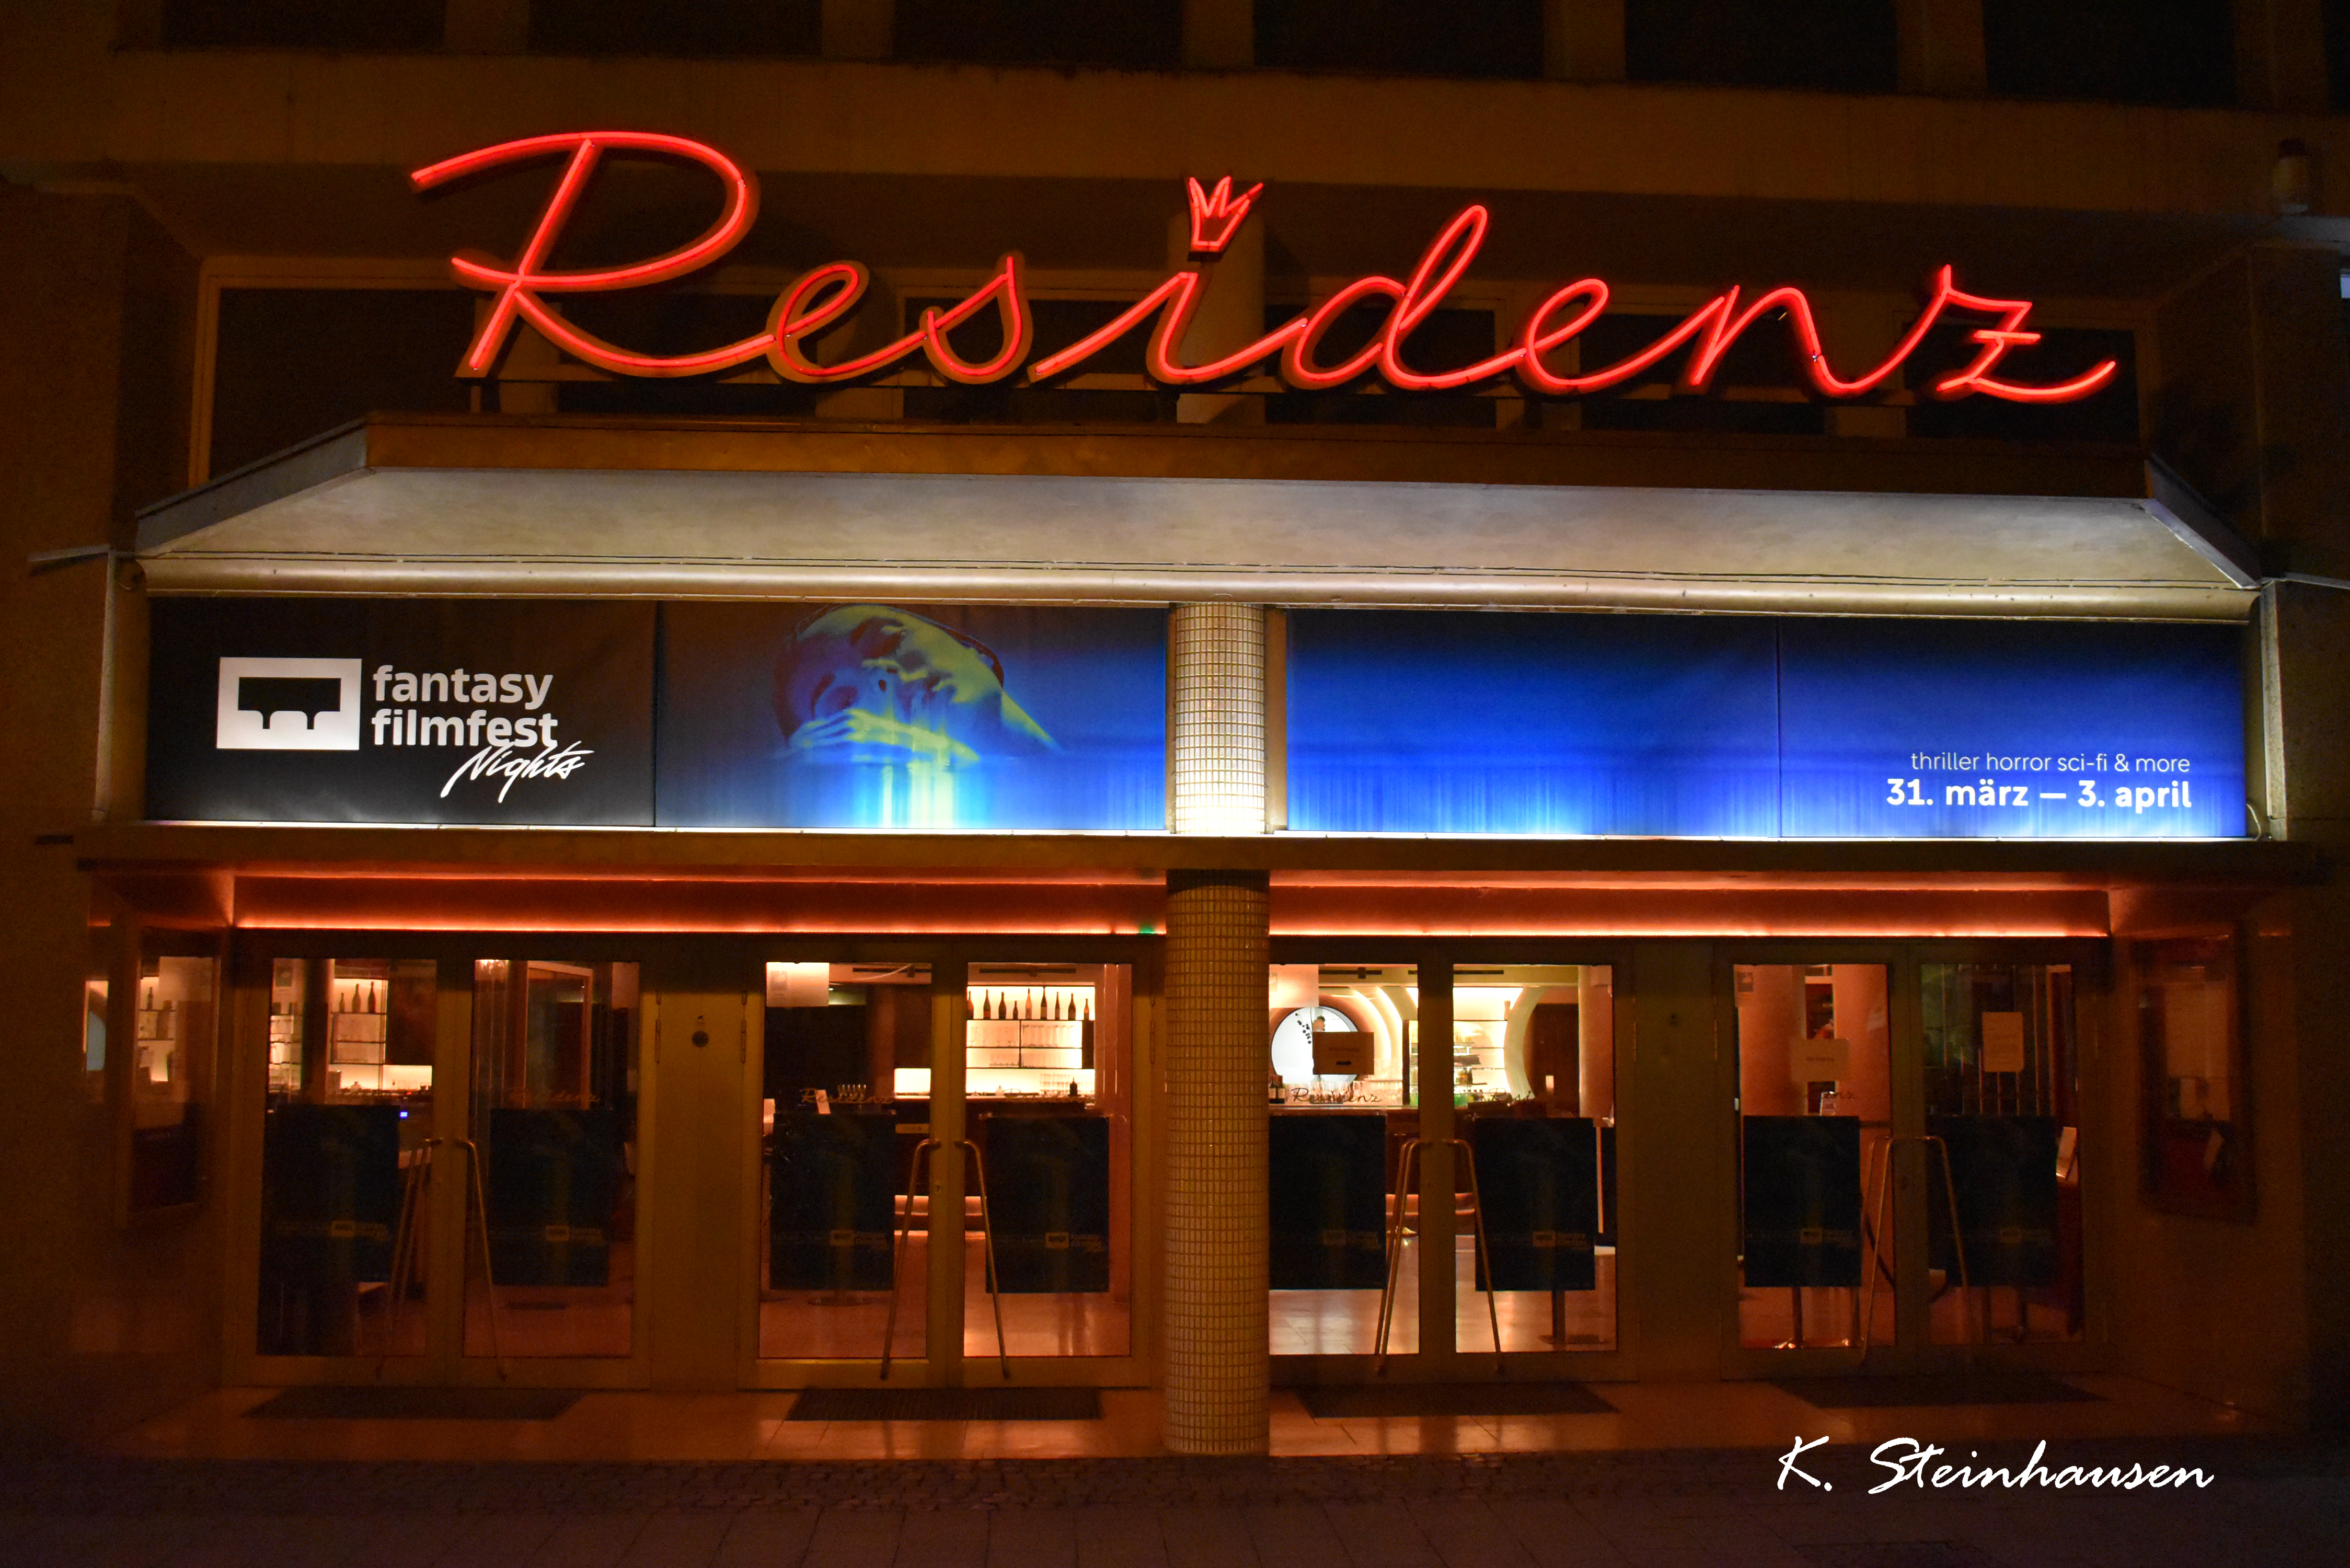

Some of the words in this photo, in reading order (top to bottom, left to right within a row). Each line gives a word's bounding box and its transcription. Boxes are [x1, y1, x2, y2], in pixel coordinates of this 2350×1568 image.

[410, 130, 2117, 402] Residenz
[372, 664, 554, 710] fantasy
[371, 709, 558, 747] filmfest
[440, 740, 595, 804] Nights
[1910, 752, 1979, 770] thriller
[1986, 753, 2052, 771] horror
[2057, 753, 2107, 772] sci-fi
[2114, 753, 2130, 772] &
[2136, 758, 2191, 773] more
[1886, 778, 1934, 806] 31.
[1945, 779, 2029, 806] märz
[2077, 780, 2105, 808] 3.
[2115, 780, 2192, 814] april
